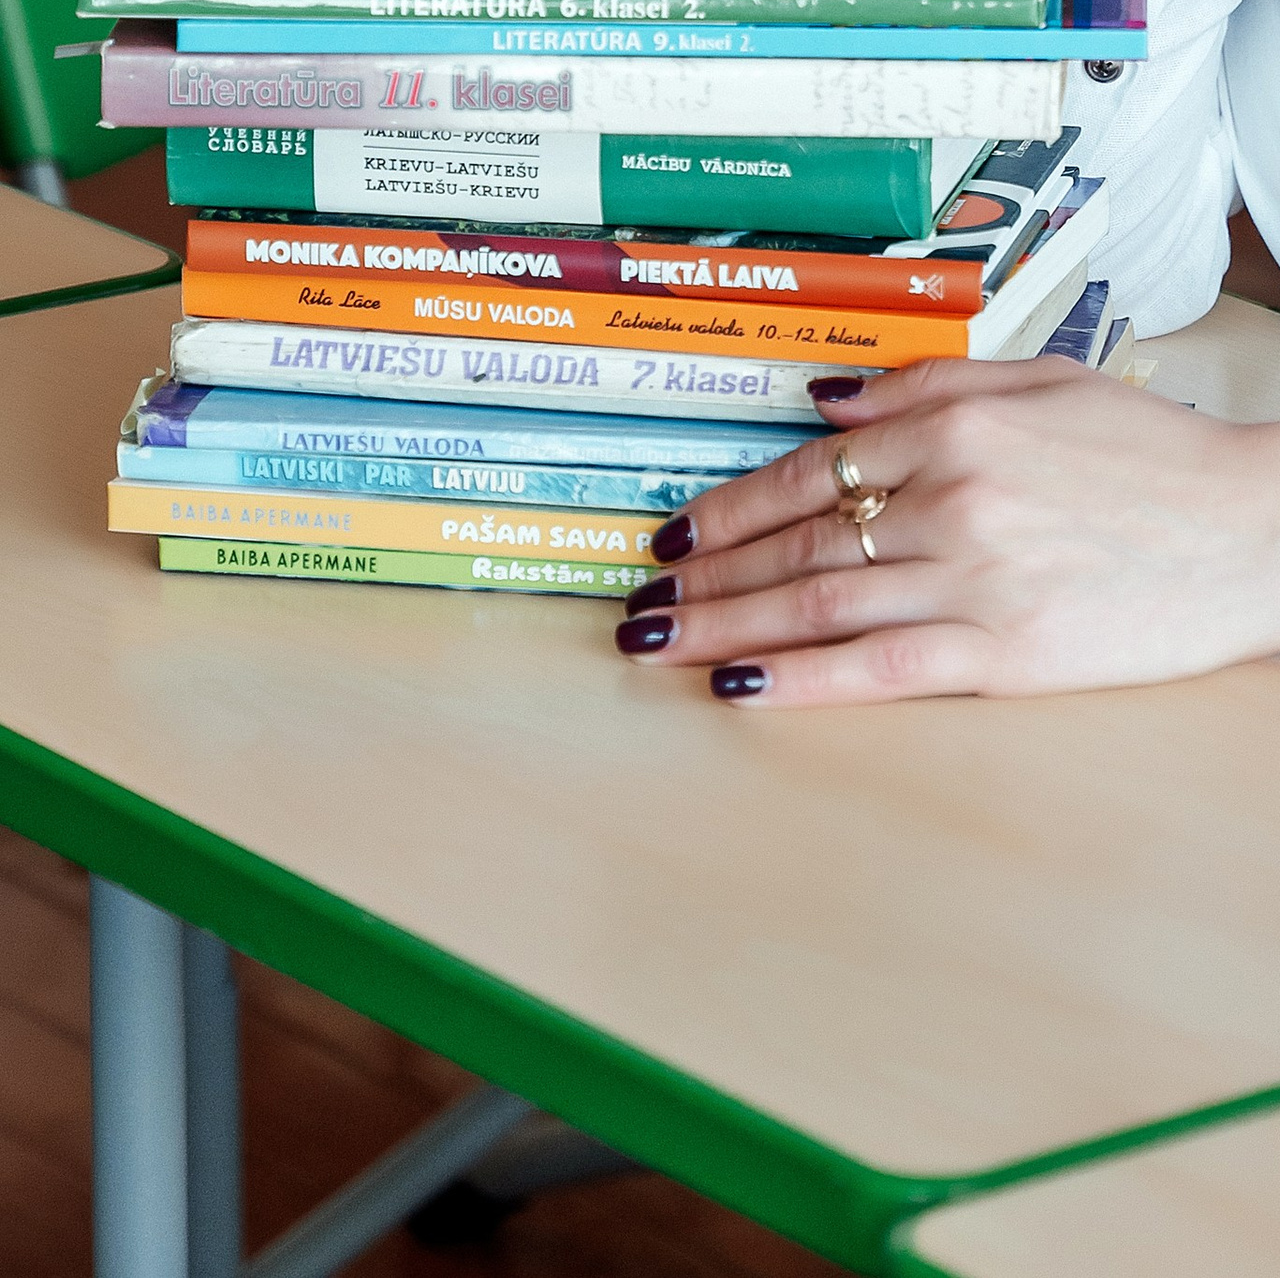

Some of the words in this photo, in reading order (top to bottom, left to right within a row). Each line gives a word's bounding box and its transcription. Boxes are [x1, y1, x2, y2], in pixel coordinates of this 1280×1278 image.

[492, 27, 642, 52] LITERATŪRA
[653, 30, 676, 52] 9.
[678, 33, 732, 52] klasei
[168, 65, 361, 109] Literatūra
[378, 68, 439, 110] 11.
[453, 64, 573, 111] klasei
[207, 126, 307, 142] УЧЕБНЫЙ
[207, 137, 308, 156] СЛОВАРЬ
[363, 157, 540, 179] KRIEVU-LATVIEŠU
[621, 153, 691, 174] MĀCĪBU
[699, 156, 792, 179] VĀRDNĪCA
[364, 178, 540, 200] LATVIEŠU-KRIEVU
[245, 239, 361, 268] MONIKA
[363, 244, 563, 279] KOMPAŅĪKOVA
[620, 257, 714, 287] PIEKTĀ
[717, 262, 800, 292] LAIVA
[298, 287, 334, 307] Rita
[338, 290, 382, 310] Lāce
[414, 294, 483, 321] MŪSU
[487, 303, 575, 329] VALODA
[605, 310, 684, 333] Latviešu
[687, 312, 745, 339] valoda
[825, 331, 880, 349] klasei
[269, 336, 447, 378] LATVIEŠU
[460, 348, 600, 387] VALODA
[629, 359, 655, 391] 7.
[664, 361, 772, 396] klasei
[282, 429, 385, 453] LATVIEŠU
[394, 435, 486, 457] VALODA
[240, 456, 344, 484] LATVISKI
[363, 460, 412, 488] PAR
[431, 466, 526, 494] LATVIJU
[170, 501, 232, 524] BAIBA
[239, 506, 353, 532] APERMANE
[441, 514, 541, 546] PAŠAM
[549, 525, 627, 553] SAVA
[216, 547, 272, 568] BAIBA
[276, 551, 378, 574] APERMANE
[471, 556, 595, 585] Rakstām
[602, 564, 648, 588] stā
